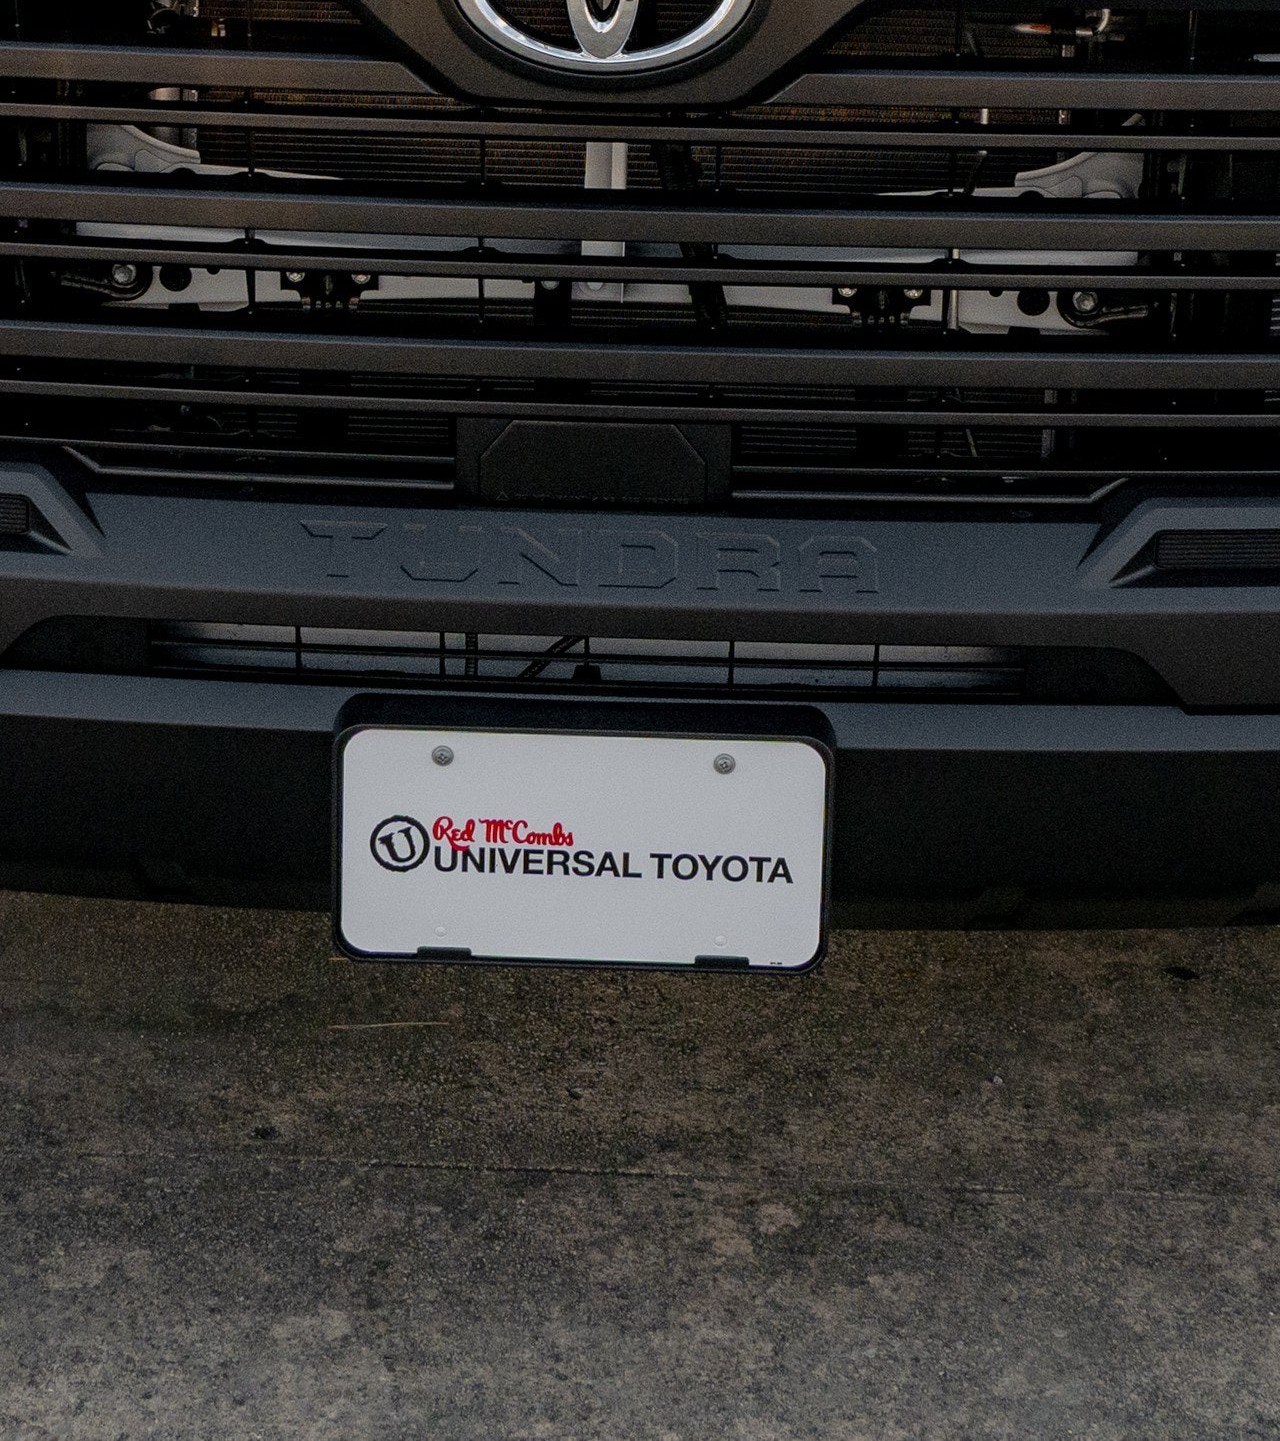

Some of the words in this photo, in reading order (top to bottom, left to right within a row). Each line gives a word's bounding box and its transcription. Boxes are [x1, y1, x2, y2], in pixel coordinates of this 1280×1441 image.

[300, 520, 878, 593] TUNDRA
[432, 815, 475, 851] Red
[479, 818, 574, 847] McCombs
[435, 846, 642, 878] UNIVERSAL
[650, 852, 794, 884] TOYOTA
